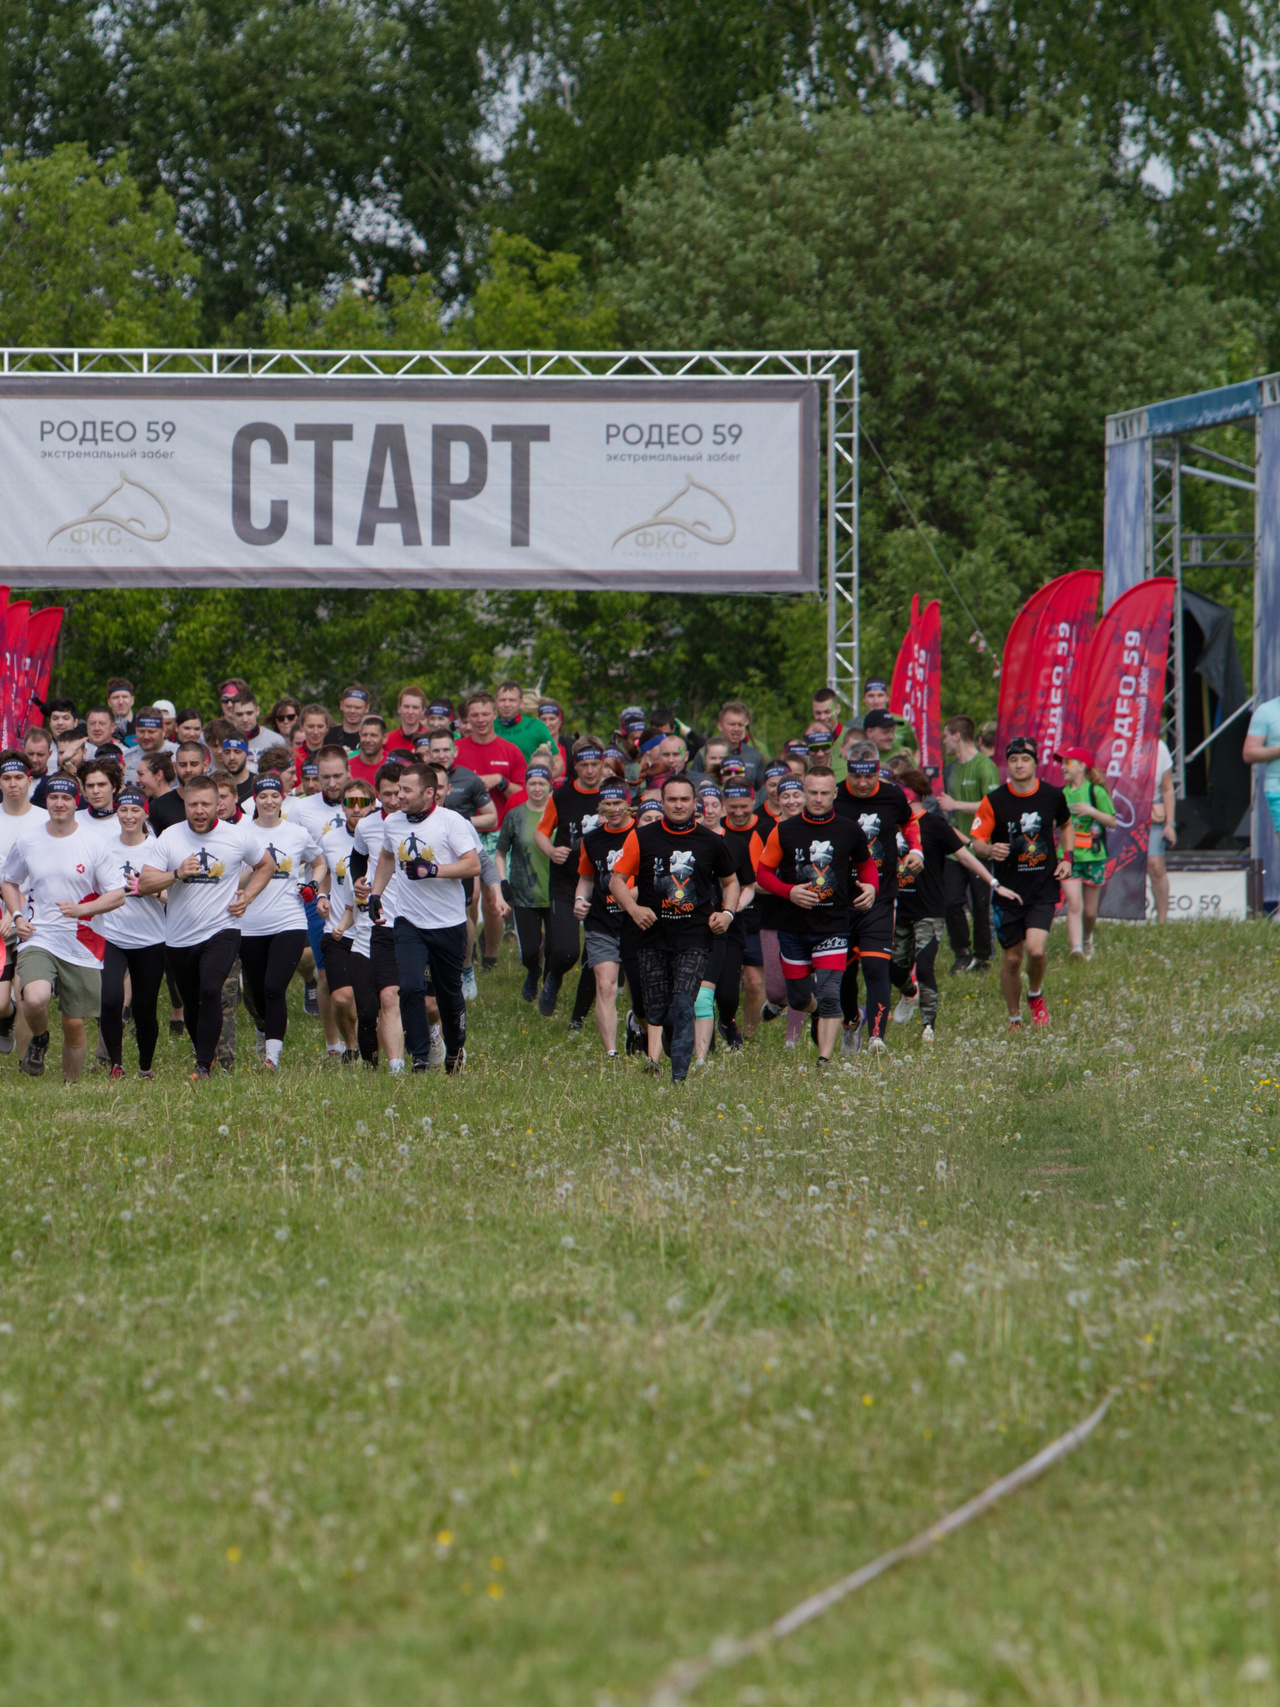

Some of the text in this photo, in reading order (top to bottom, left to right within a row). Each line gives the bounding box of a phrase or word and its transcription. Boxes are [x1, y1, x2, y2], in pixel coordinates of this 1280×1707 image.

[39, 420, 177, 447] РОДЕО 59
[605, 423, 744, 450] РОДЕО 59
[40, 449, 176, 461] экстремальный забег
[606, 452, 743, 465] экстремальный забег
[231, 421, 551, 547] СТАРТ
[70, 527, 122, 546] ФКС
[634, 531, 687, 550] ФКС
[1124, 630, 1142, 667] 59
[1199, 894, 1222, 911] 59
